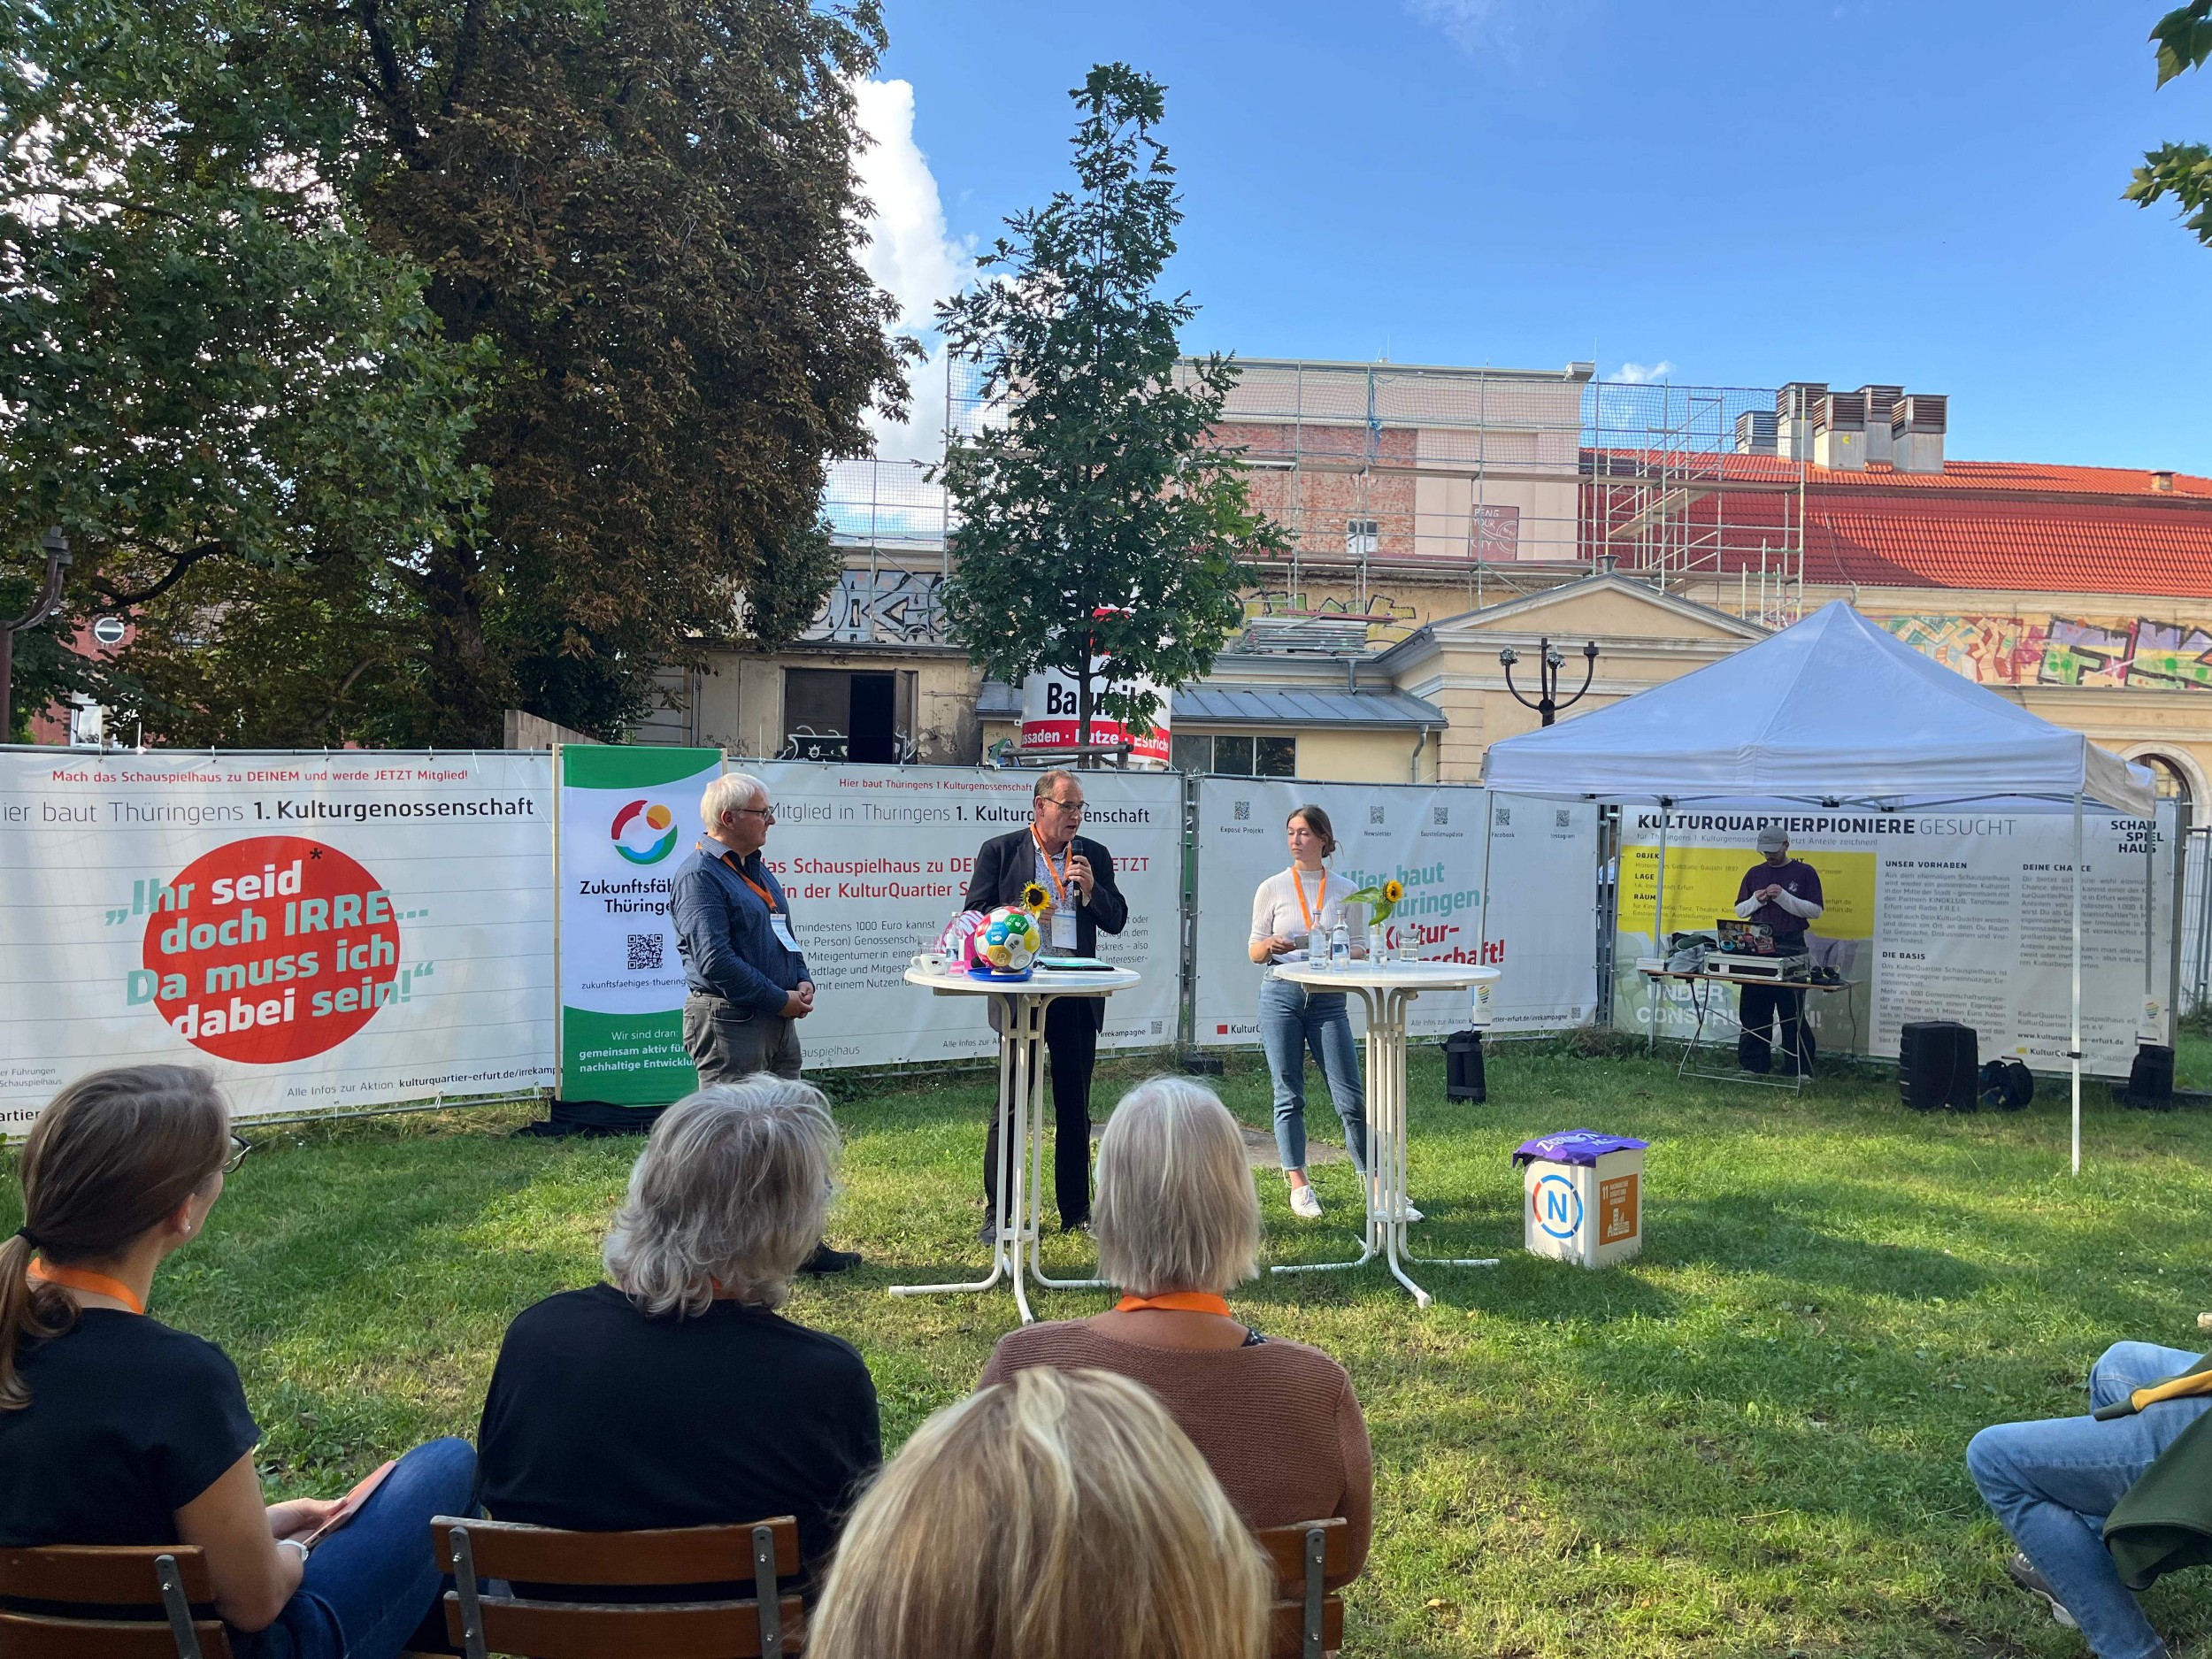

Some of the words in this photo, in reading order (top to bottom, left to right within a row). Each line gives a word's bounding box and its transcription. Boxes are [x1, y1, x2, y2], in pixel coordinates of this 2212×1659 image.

[1470, 539, 1493, 550] CTY
[52, 771, 88, 782] Mach
[94, 771, 117, 782] das
[121, 772, 222, 784] Schauspielhaus
[227, 773, 242, 782] zu
[247, 771, 300, 782] DEINEM
[304, 771, 327, 781] und
[332, 771, 369, 781] werde
[373, 770, 412, 780] JETZT
[418, 769, 468, 782] Mitglied!
[840, 779, 859, 787] Hier
[863, 779, 883, 788] baut
[886, 780, 933, 790] Thüringens
[944, 780, 1033, 792] Kulturgenossenschaft
[4, 802, 30, 822] ier
[43, 802, 97, 822] baut
[108, 801, 244, 826] Thüringens
[254, 800, 271, 820] 1.
[277, 797, 534, 822] Kulturgenossenschaft
[840, 804, 854, 820] in
[862, 804, 950, 825] Thüringens
[956, 805, 968, 821] 1.
[1920, 818, 2017, 836] GESUCHT
[794, 857, 921, 877] Schauspielhaus
[926, 861, 944, 873] zu
[1112, 857, 1149, 872] ETZT
[1395, 862, 1445, 888] baut
[579, 878, 673, 895] Zukunftsfäh
[803, 883, 832, 898] der
[838, 882, 953, 899] KulturQuartier
[603, 898, 671, 916] Thüringe
[795, 922, 852, 933] mindestens
[856, 921, 878, 931] 1000
[881, 921, 902, 930] Euro
[905, 920, 935, 929] kannst
[1133, 916, 1148, 925] oder
[160, 908, 266, 955] doch
[1132, 927, 1148, 937] dem
[814, 936, 851, 948] Person)
[855, 934, 918, 946] Genossensch
[1133, 941, 1148, 950] also
[892, 949, 916, 959] einer
[127, 969, 187, 1006] Da
[205, 950, 319, 995] muss
[336, 933, 395, 972] ich
[850, 964, 868, 974] und
[871, 963, 910, 973] Mitgesta
[581, 978, 687, 989] zukunftsfaehiges-thuering
[816, 980, 832, 990] mit
[834, 979, 864, 990] einem
[866, 977, 900, 987] Nutzen
[1647, 984, 1724, 1002] UNDER
[172, 988, 296, 1041] dabei
[611, 1032, 628, 1041] Wir
[631, 1029, 651, 1040] sind
[655, 1028, 679, 1039] dran:
[943, 1039, 957, 1048] Alle
[959, 1038, 975, 1047] Infos
[579, 1047, 639, 1060] gemeinsam
[641, 1044, 668, 1055] aktiv
[670, 1043, 686, 1053] für
[801, 1045, 860, 1058] auspielhaus
[12, 1068, 56, 1077] Führungen
[580, 1060, 641, 1072] nachhaltige
[287, 1087, 307, 1097] Alle
[311, 1085, 336, 1096] Infos
[0, 1109, 41, 1122] artier
[1548, 1190, 1567, 1224] N
